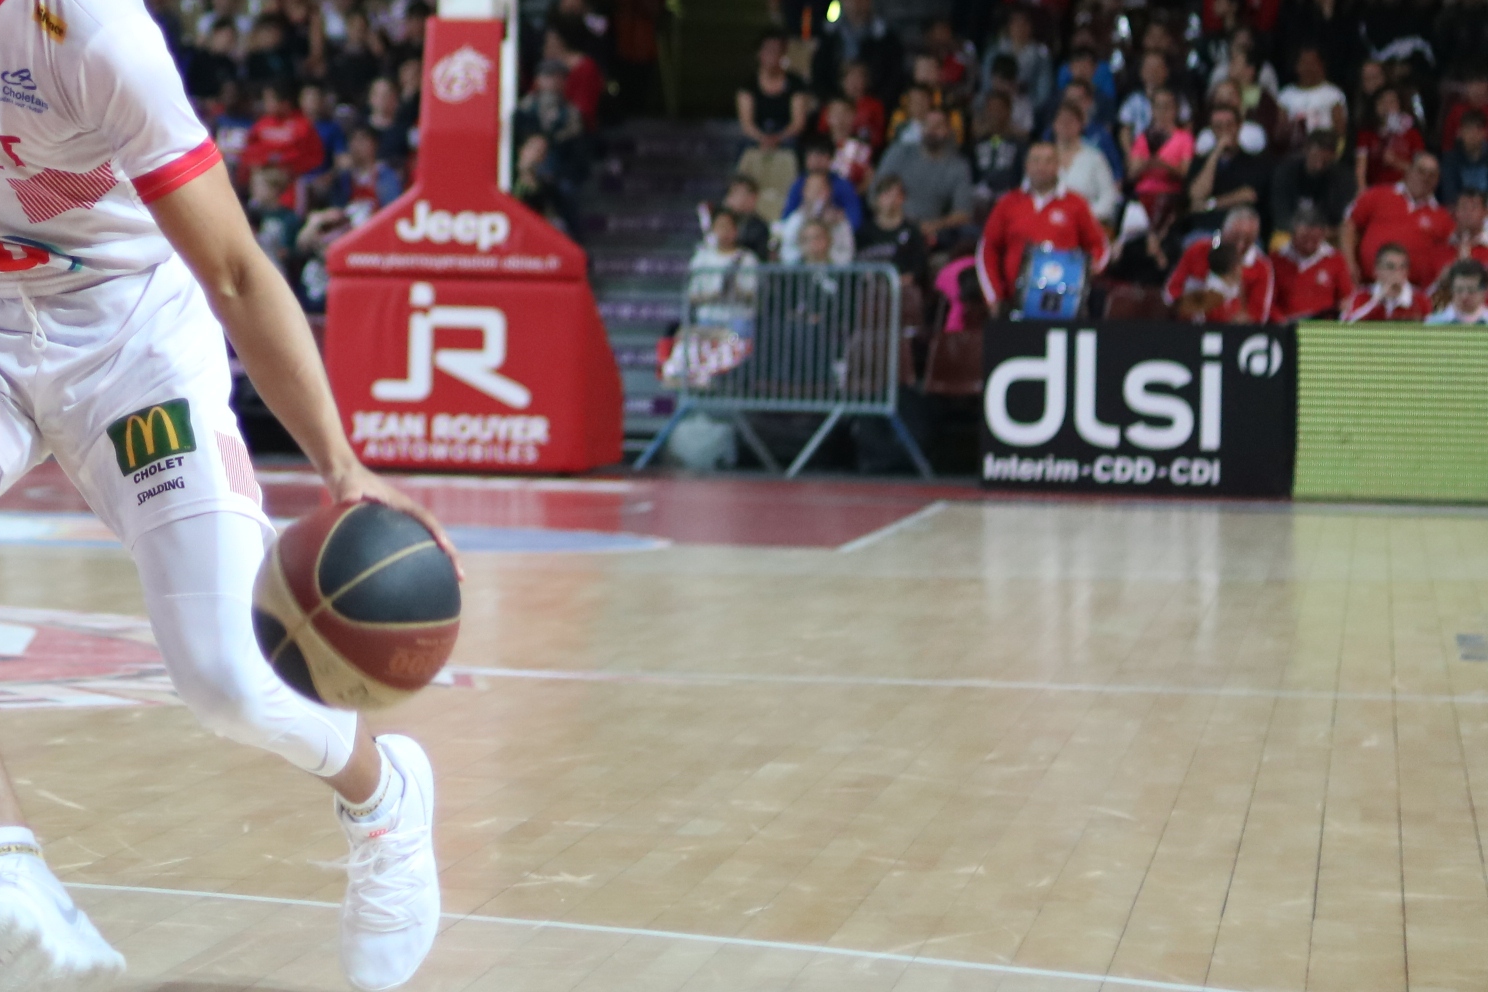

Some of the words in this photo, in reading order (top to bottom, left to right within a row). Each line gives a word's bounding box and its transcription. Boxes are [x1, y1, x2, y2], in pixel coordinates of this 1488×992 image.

[395, 201, 510, 251] Jeep
[983, 328, 1224, 452] dlsi
[351, 410, 426, 444] JEAN
[431, 412, 551, 446] ROUYER
[363, 440, 540, 465] AUTOMOBILES
[133, 455, 185, 485] CHOLET
[136, 475, 186, 507] SPALDING
